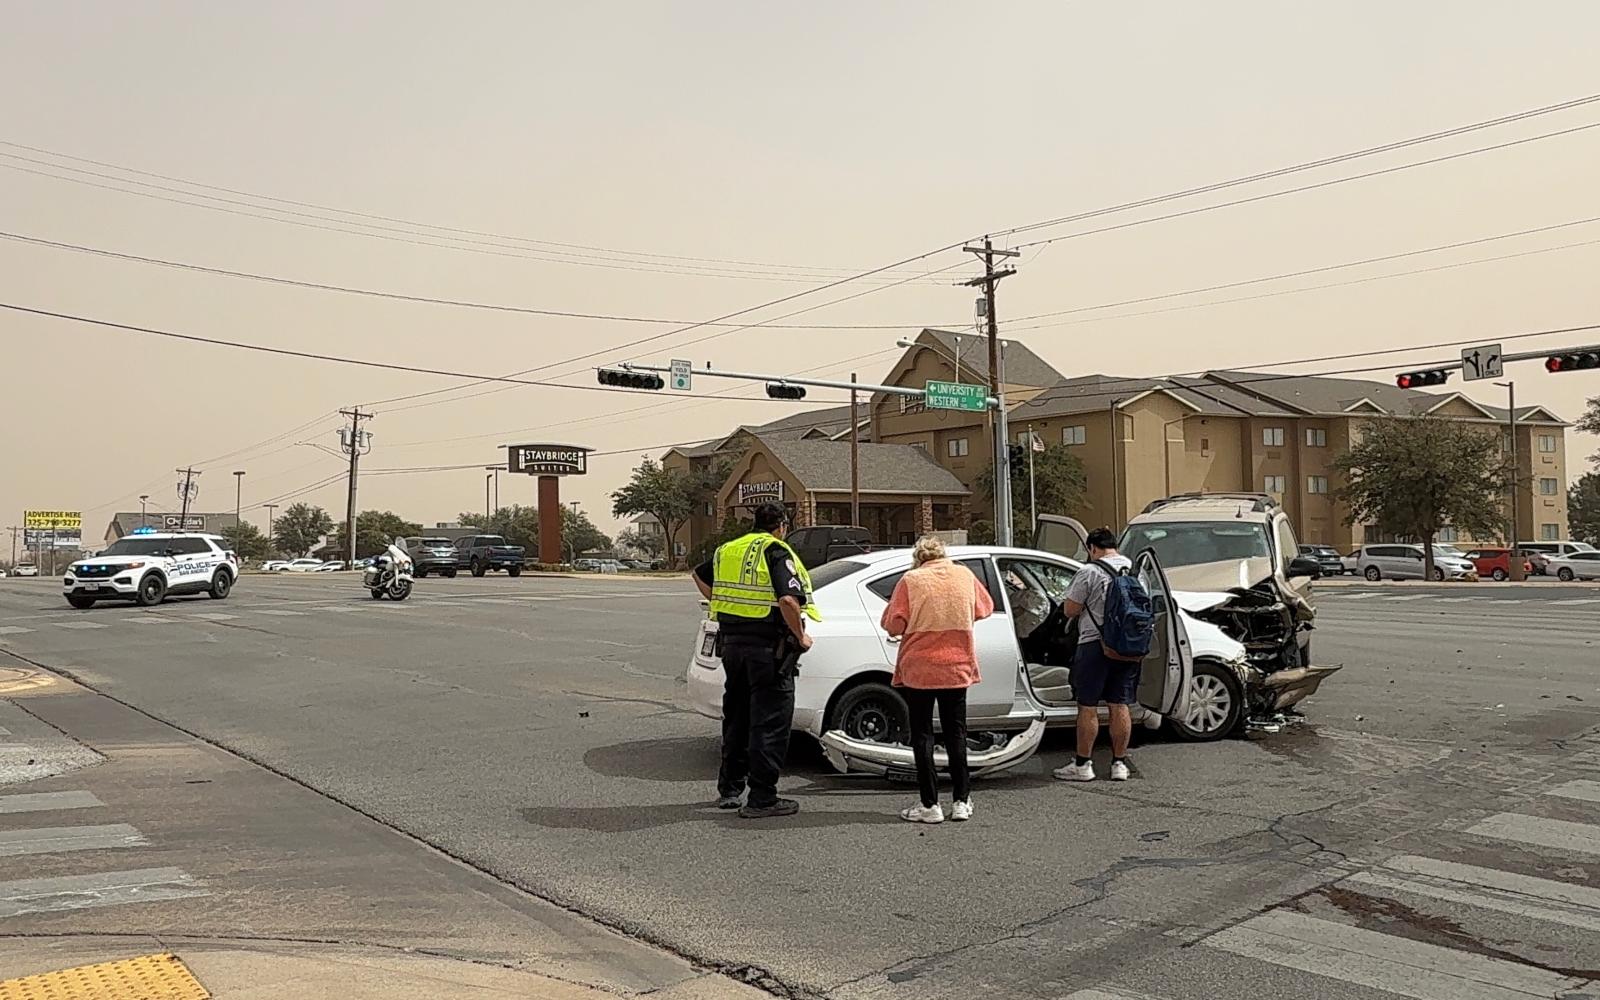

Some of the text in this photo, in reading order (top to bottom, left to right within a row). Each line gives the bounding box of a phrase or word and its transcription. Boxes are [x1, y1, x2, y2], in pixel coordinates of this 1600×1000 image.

[937, 383, 975, 396] UNIVERSITY
[928, 395, 959, 407] WESTERN
[525, 450, 578, 461] STAYBRIDGE
[743, 482, 779, 493] STAYBRIDGE
[177, 562, 210, 570] POLICE
